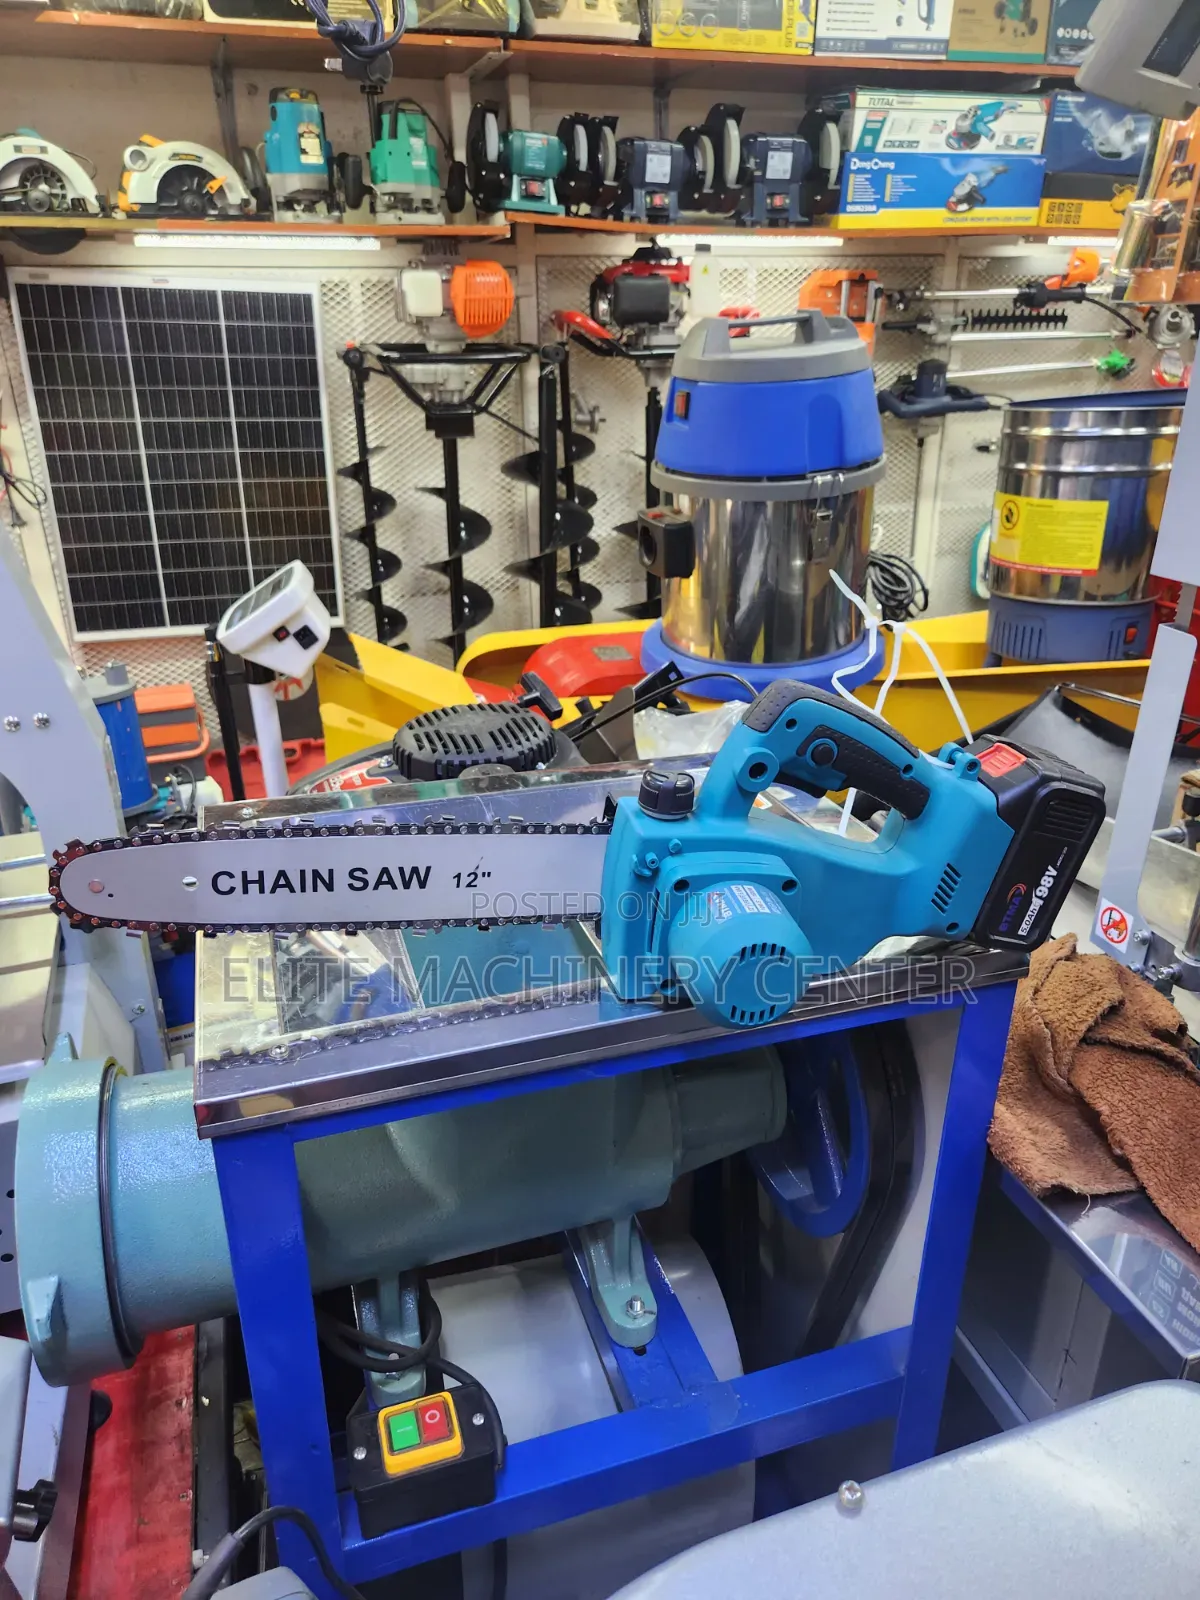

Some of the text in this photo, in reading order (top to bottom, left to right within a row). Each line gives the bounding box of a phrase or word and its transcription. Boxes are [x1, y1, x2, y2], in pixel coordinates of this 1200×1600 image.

[868, 97, 895, 107] TOTAL
[211, 865, 492, 895] CHAIN SAW 12"
[1020, 908, 1037, 935] 5.0Ah
